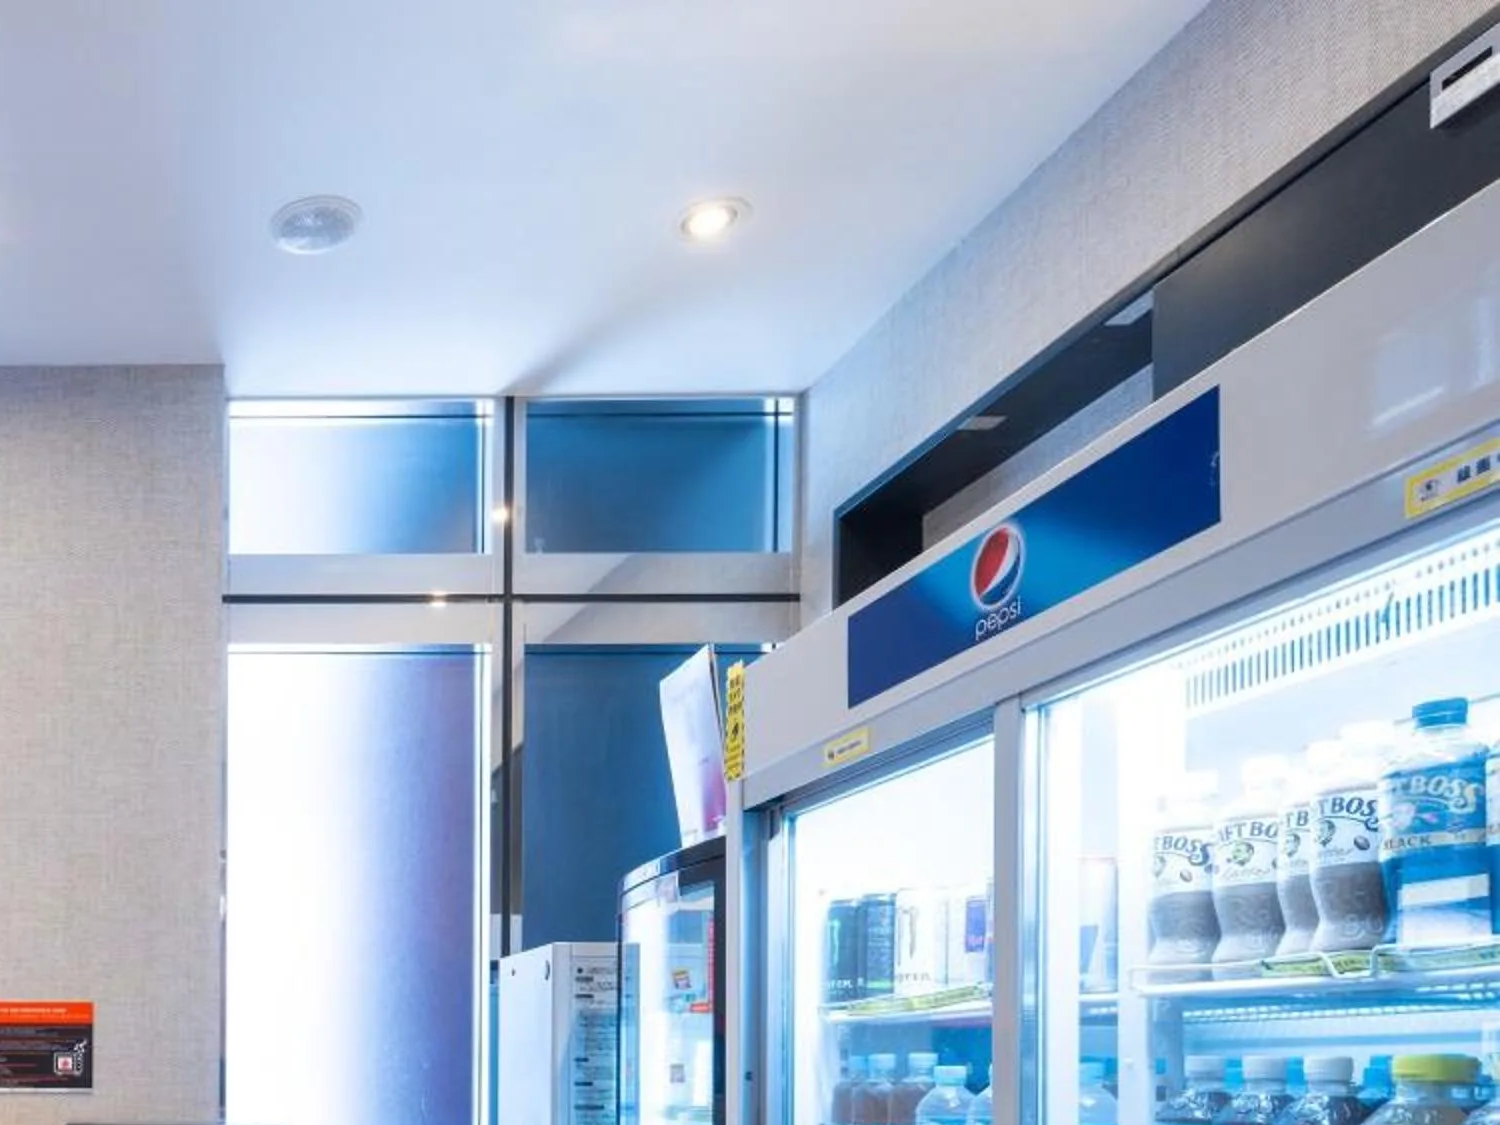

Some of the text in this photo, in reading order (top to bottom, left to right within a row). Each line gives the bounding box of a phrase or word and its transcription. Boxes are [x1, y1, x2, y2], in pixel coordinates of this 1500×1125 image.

[974, 595, 1022, 640] pepsi
[1410, 775, 1485, 814] BOSS
[1250, 819, 1279, 840] BO
[1162, 835, 1209, 867] BOSS
